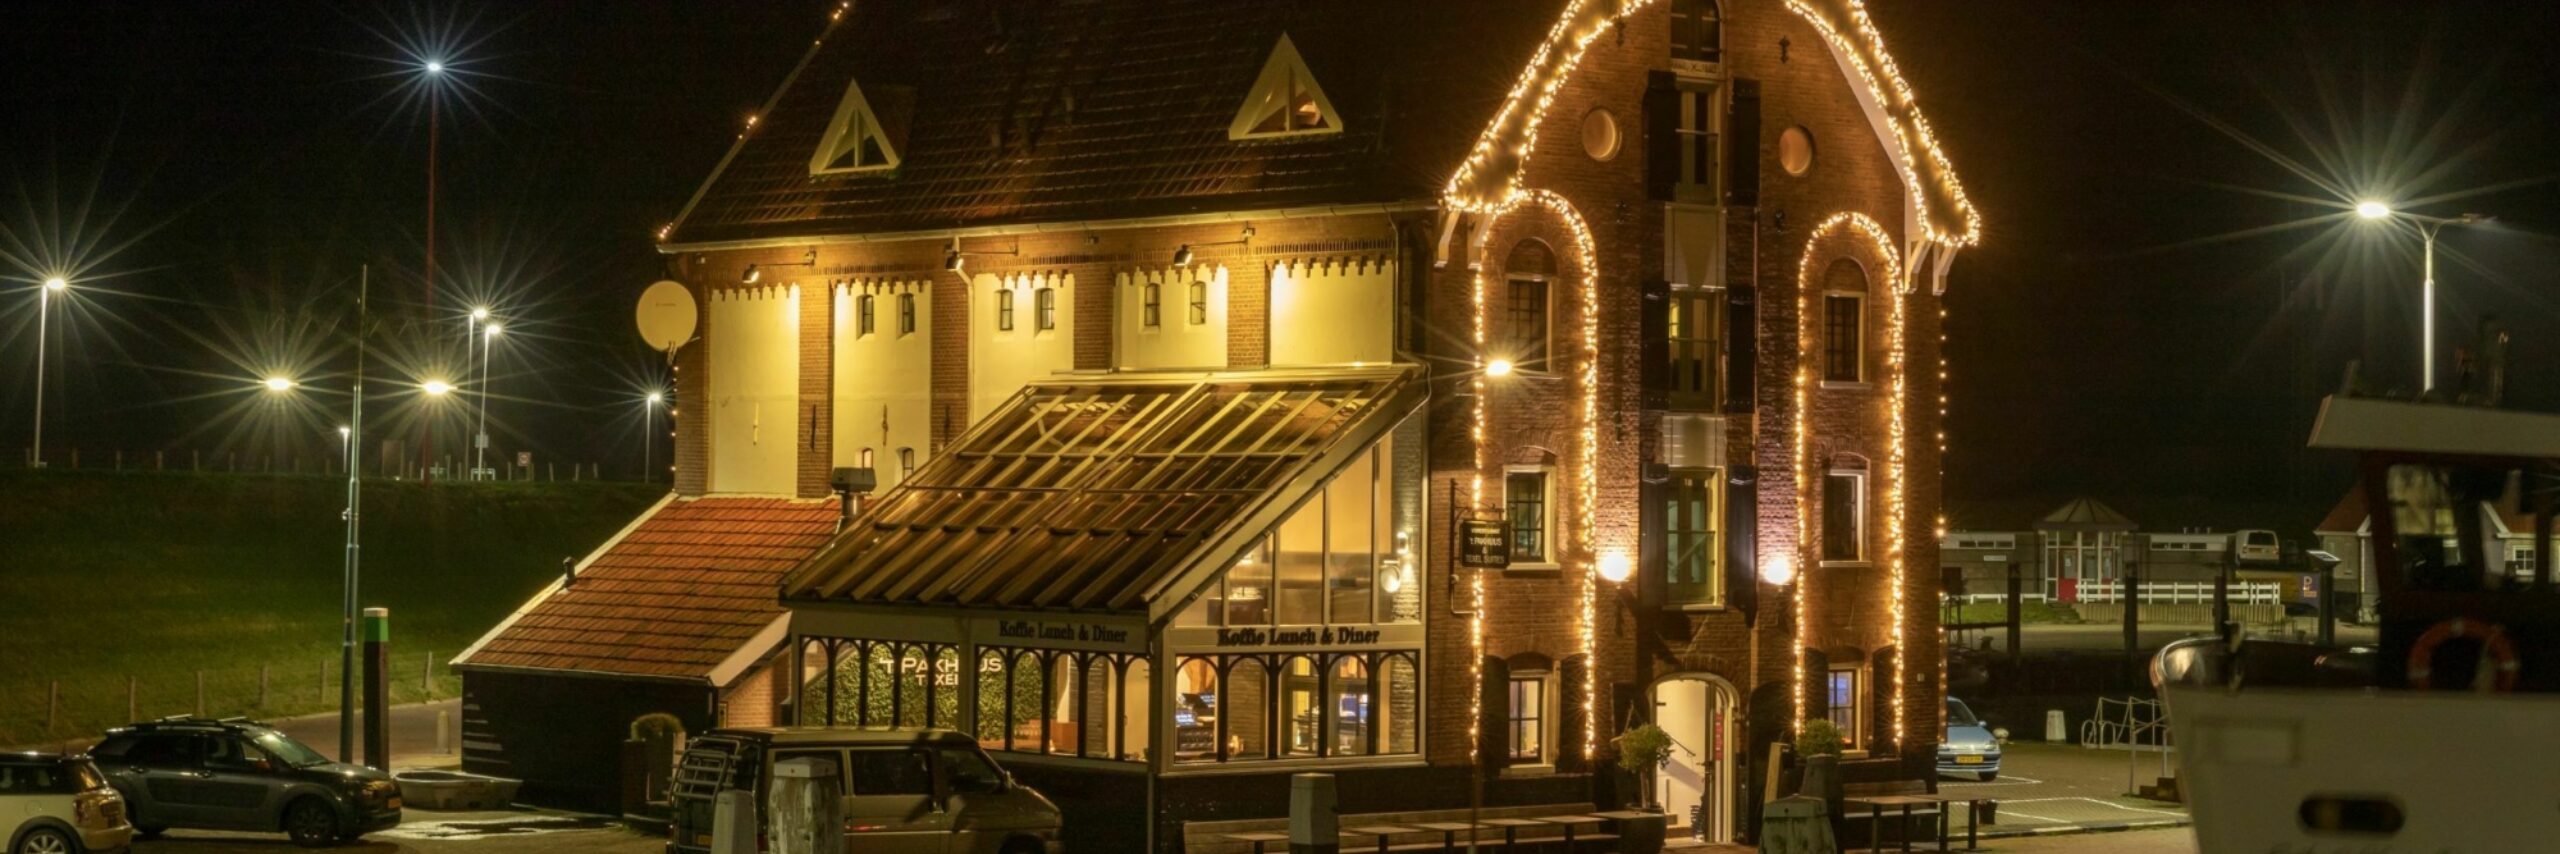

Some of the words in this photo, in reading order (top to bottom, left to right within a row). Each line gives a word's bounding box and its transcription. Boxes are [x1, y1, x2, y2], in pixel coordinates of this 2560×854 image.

[999, 620, 1035, 638] Koffie
[1038, 622, 1075, 640] Lunch
[1078, 624, 1089, 641] &
[1092, 625, 1128, 642] Diner
[1217, 627, 1265, 646] Koffie
[1269, 627, 1316, 645] Lunch
[1320, 627, 1334, 645] &
[1338, 626, 1380, 644] Diner
